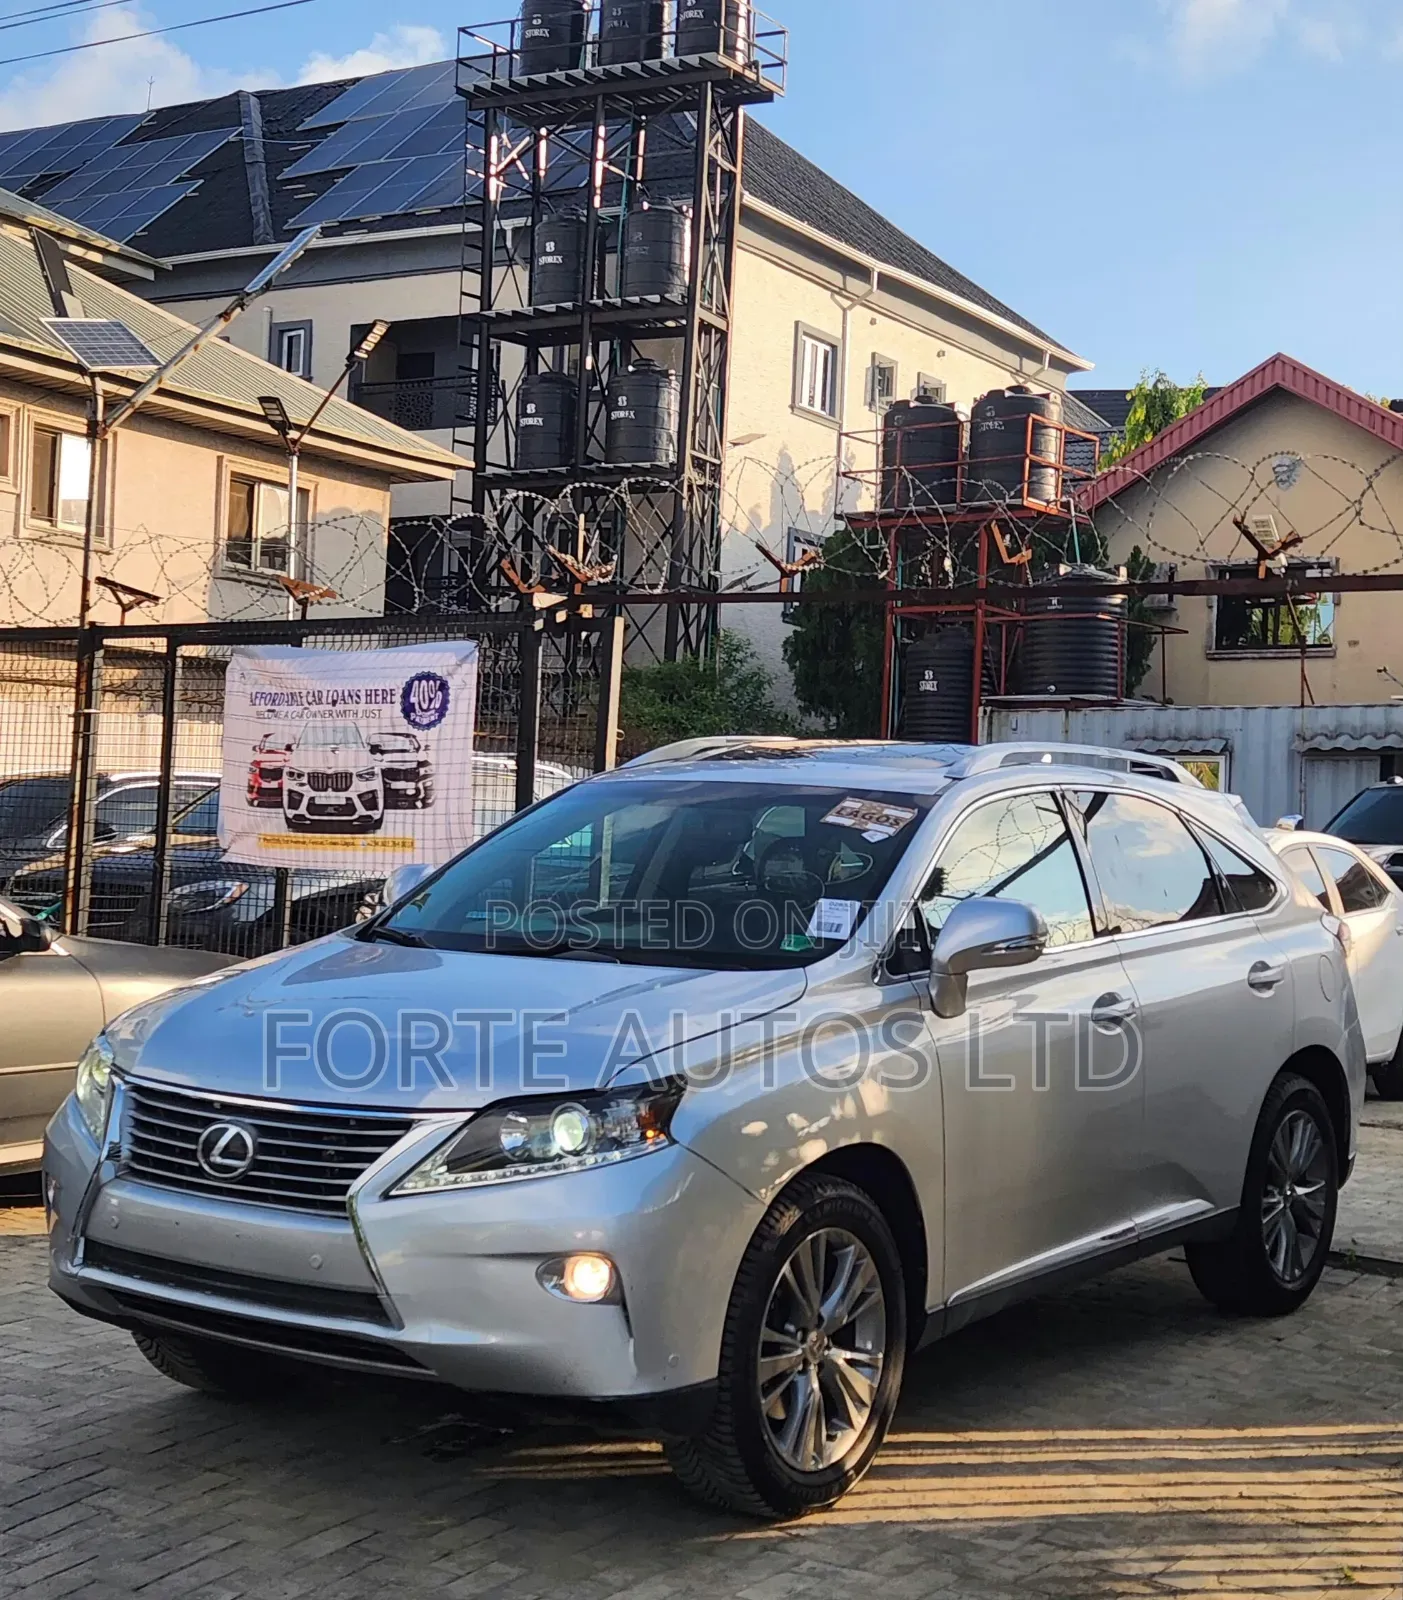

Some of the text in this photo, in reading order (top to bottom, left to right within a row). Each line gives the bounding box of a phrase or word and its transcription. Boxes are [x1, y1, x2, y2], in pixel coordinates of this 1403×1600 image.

[306, 690, 324, 706] CAR
[325, 689, 361, 705] LOANS
[364, 688, 396, 704] HERE
[410, 680, 442, 710] 40%
[335, 709, 359, 719] WITH
[360, 709, 382, 719] JUST
[835, 807, 902, 827] LAGOS
